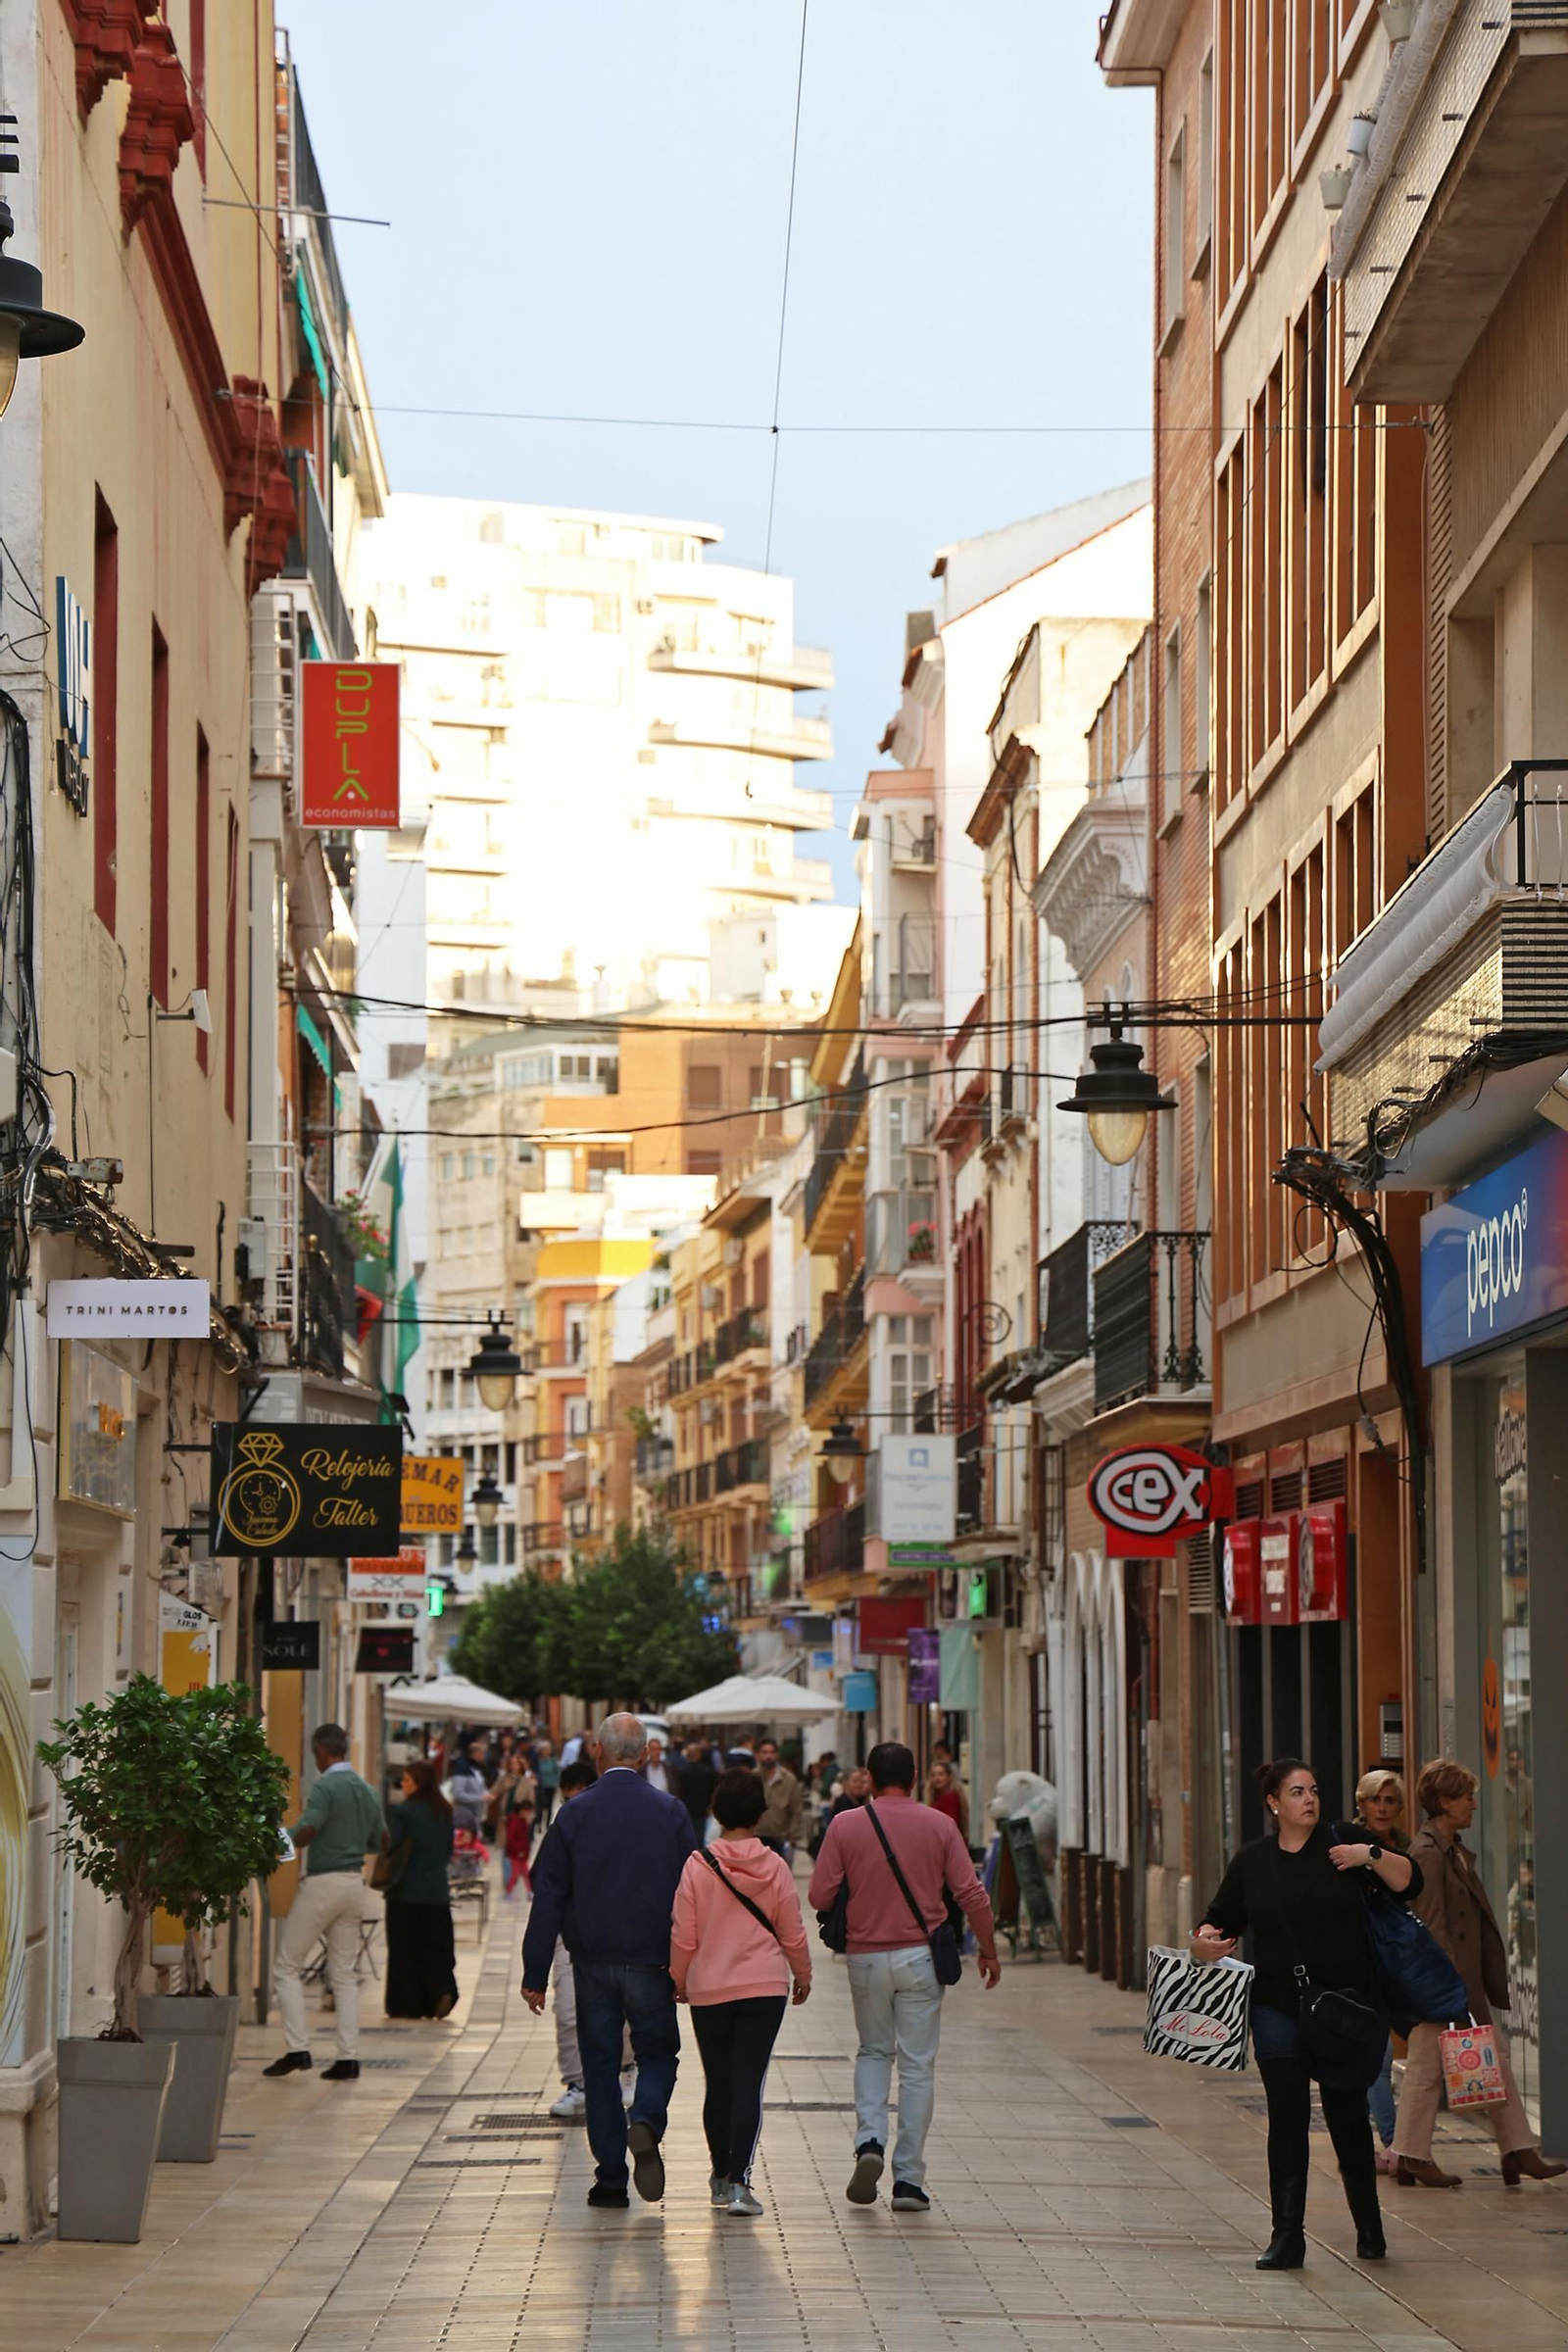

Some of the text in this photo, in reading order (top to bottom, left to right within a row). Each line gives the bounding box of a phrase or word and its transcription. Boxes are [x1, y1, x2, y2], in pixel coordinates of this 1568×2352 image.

[305, 807, 396, 819] economistas
[1467, 1203, 1523, 1339] pepco
[66, 1305, 188, 1315] TRINI MARTOS
[300, 1448, 395, 1491] Relojería
[313, 1496, 379, 1529] Taller
[1159, 2012, 1228, 2040] Mi Lola
